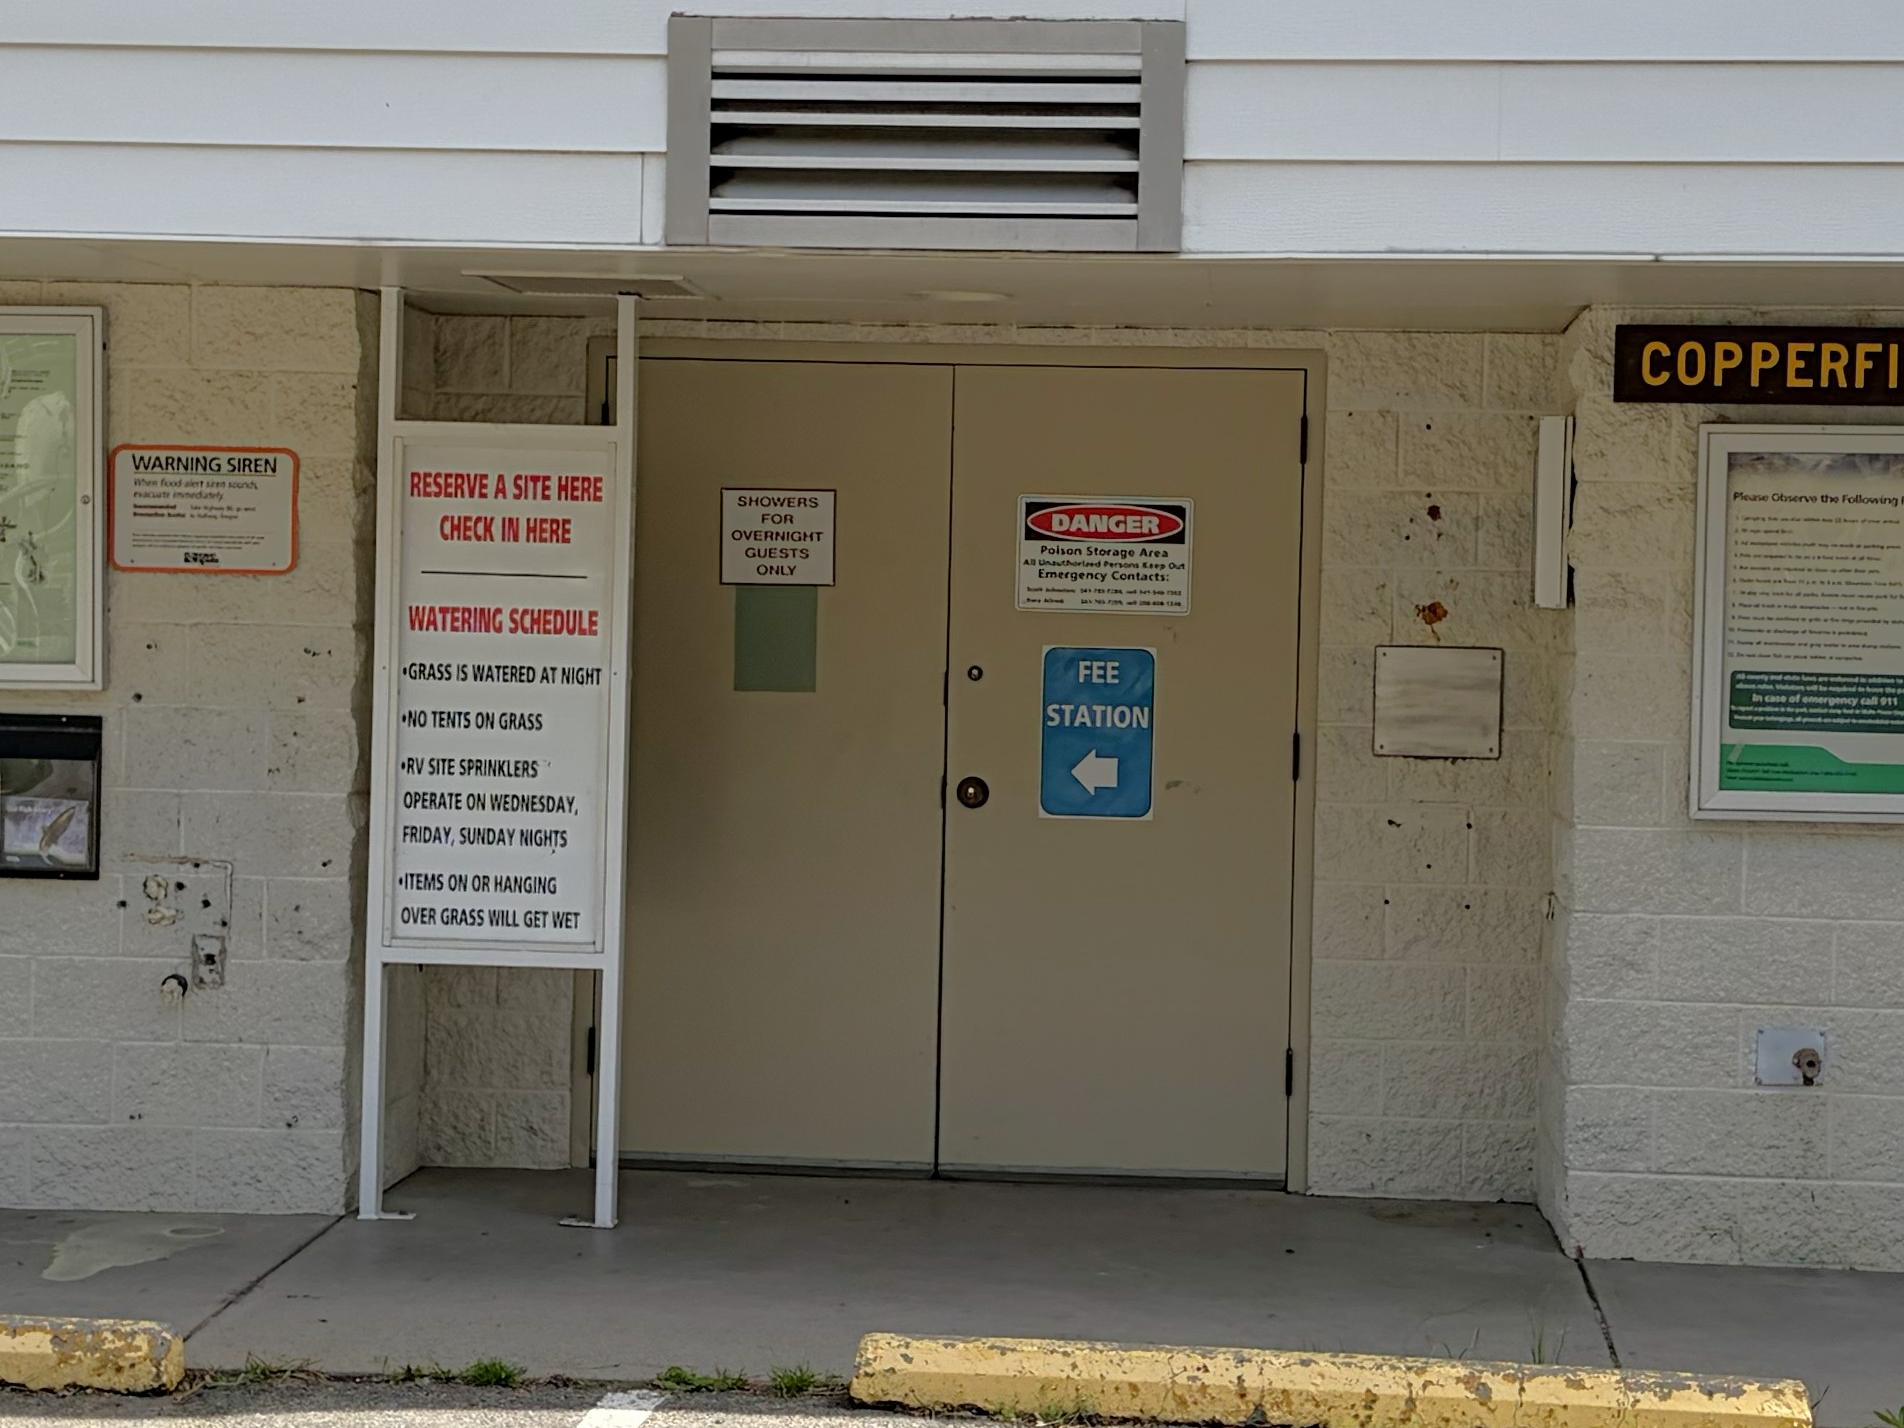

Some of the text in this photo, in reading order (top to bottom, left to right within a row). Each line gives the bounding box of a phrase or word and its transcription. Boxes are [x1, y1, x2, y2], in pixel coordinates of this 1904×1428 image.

[132, 453, 278, 474] WARNING SIREN
[134, 478, 158, 487] When
[206, 480, 226, 488] siren
[409, 471, 604, 502] RESERVE A SITE HERE
[736, 495, 819, 509] SHOWERS
[1732, 491, 1769, 502] Please
[1771, 492, 1818, 503] Observe
[1820, 494, 1839, 504] the
[1841, 494, 1899, 508] Following
[439, 514, 572, 544] CHECK IN HERE
[760, 512, 795, 526] FOR
[1051, 513, 1160, 534] DANGER
[730, 529, 824, 544] OVERNIGHT
[743, 546, 810, 561] GUESTS
[1040, 545, 1169, 559] Poison Storage Area
[755, 562, 798, 577] ONLY
[1038, 559, 1101, 568] Unauthorized
[1104, 560, 1139, 569] Persons
[1142, 562, 1165, 571] Keep
[1168, 562, 1185, 570] Out
[1038, 569, 1170, 583] Emergency Contacts:
[408, 605, 599, 637] WATERING SCHEDULE
[456, 664, 468, 682] IS
[472, 664, 536, 684] WATERED
[540, 666, 557, 684] AT
[561, 667, 603, 685] NIGHT
[1078, 661, 1120, 685] FEE
[1764, 695, 1787, 703] case
[1788, 694, 1800, 703] of
[1802, 696, 1858, 707] emergency
[1860, 697, 1878, 706] call
[1879, 698, 1898, 706] 911
[431, 710, 471, 729] TENTS
[475, 712, 495, 730] ON
[499, 712, 543, 731] GRASS
[1045, 704, 1150, 729] STATION
[428, 758, 455, 776] SITE
[459, 758, 539, 778] SPRINKLERS
[403, 791, 579, 816] OPERATE ON WEDNESDAY,
[402, 825, 568, 848] FRIDAY, SUNDAY NIGHTS
[448, 874, 468, 892] ON
[471, 874, 490, 893] OR
[494, 875, 557, 895] HANGING
[401, 907, 581, 929] OVER GRASS WILL GET WET
